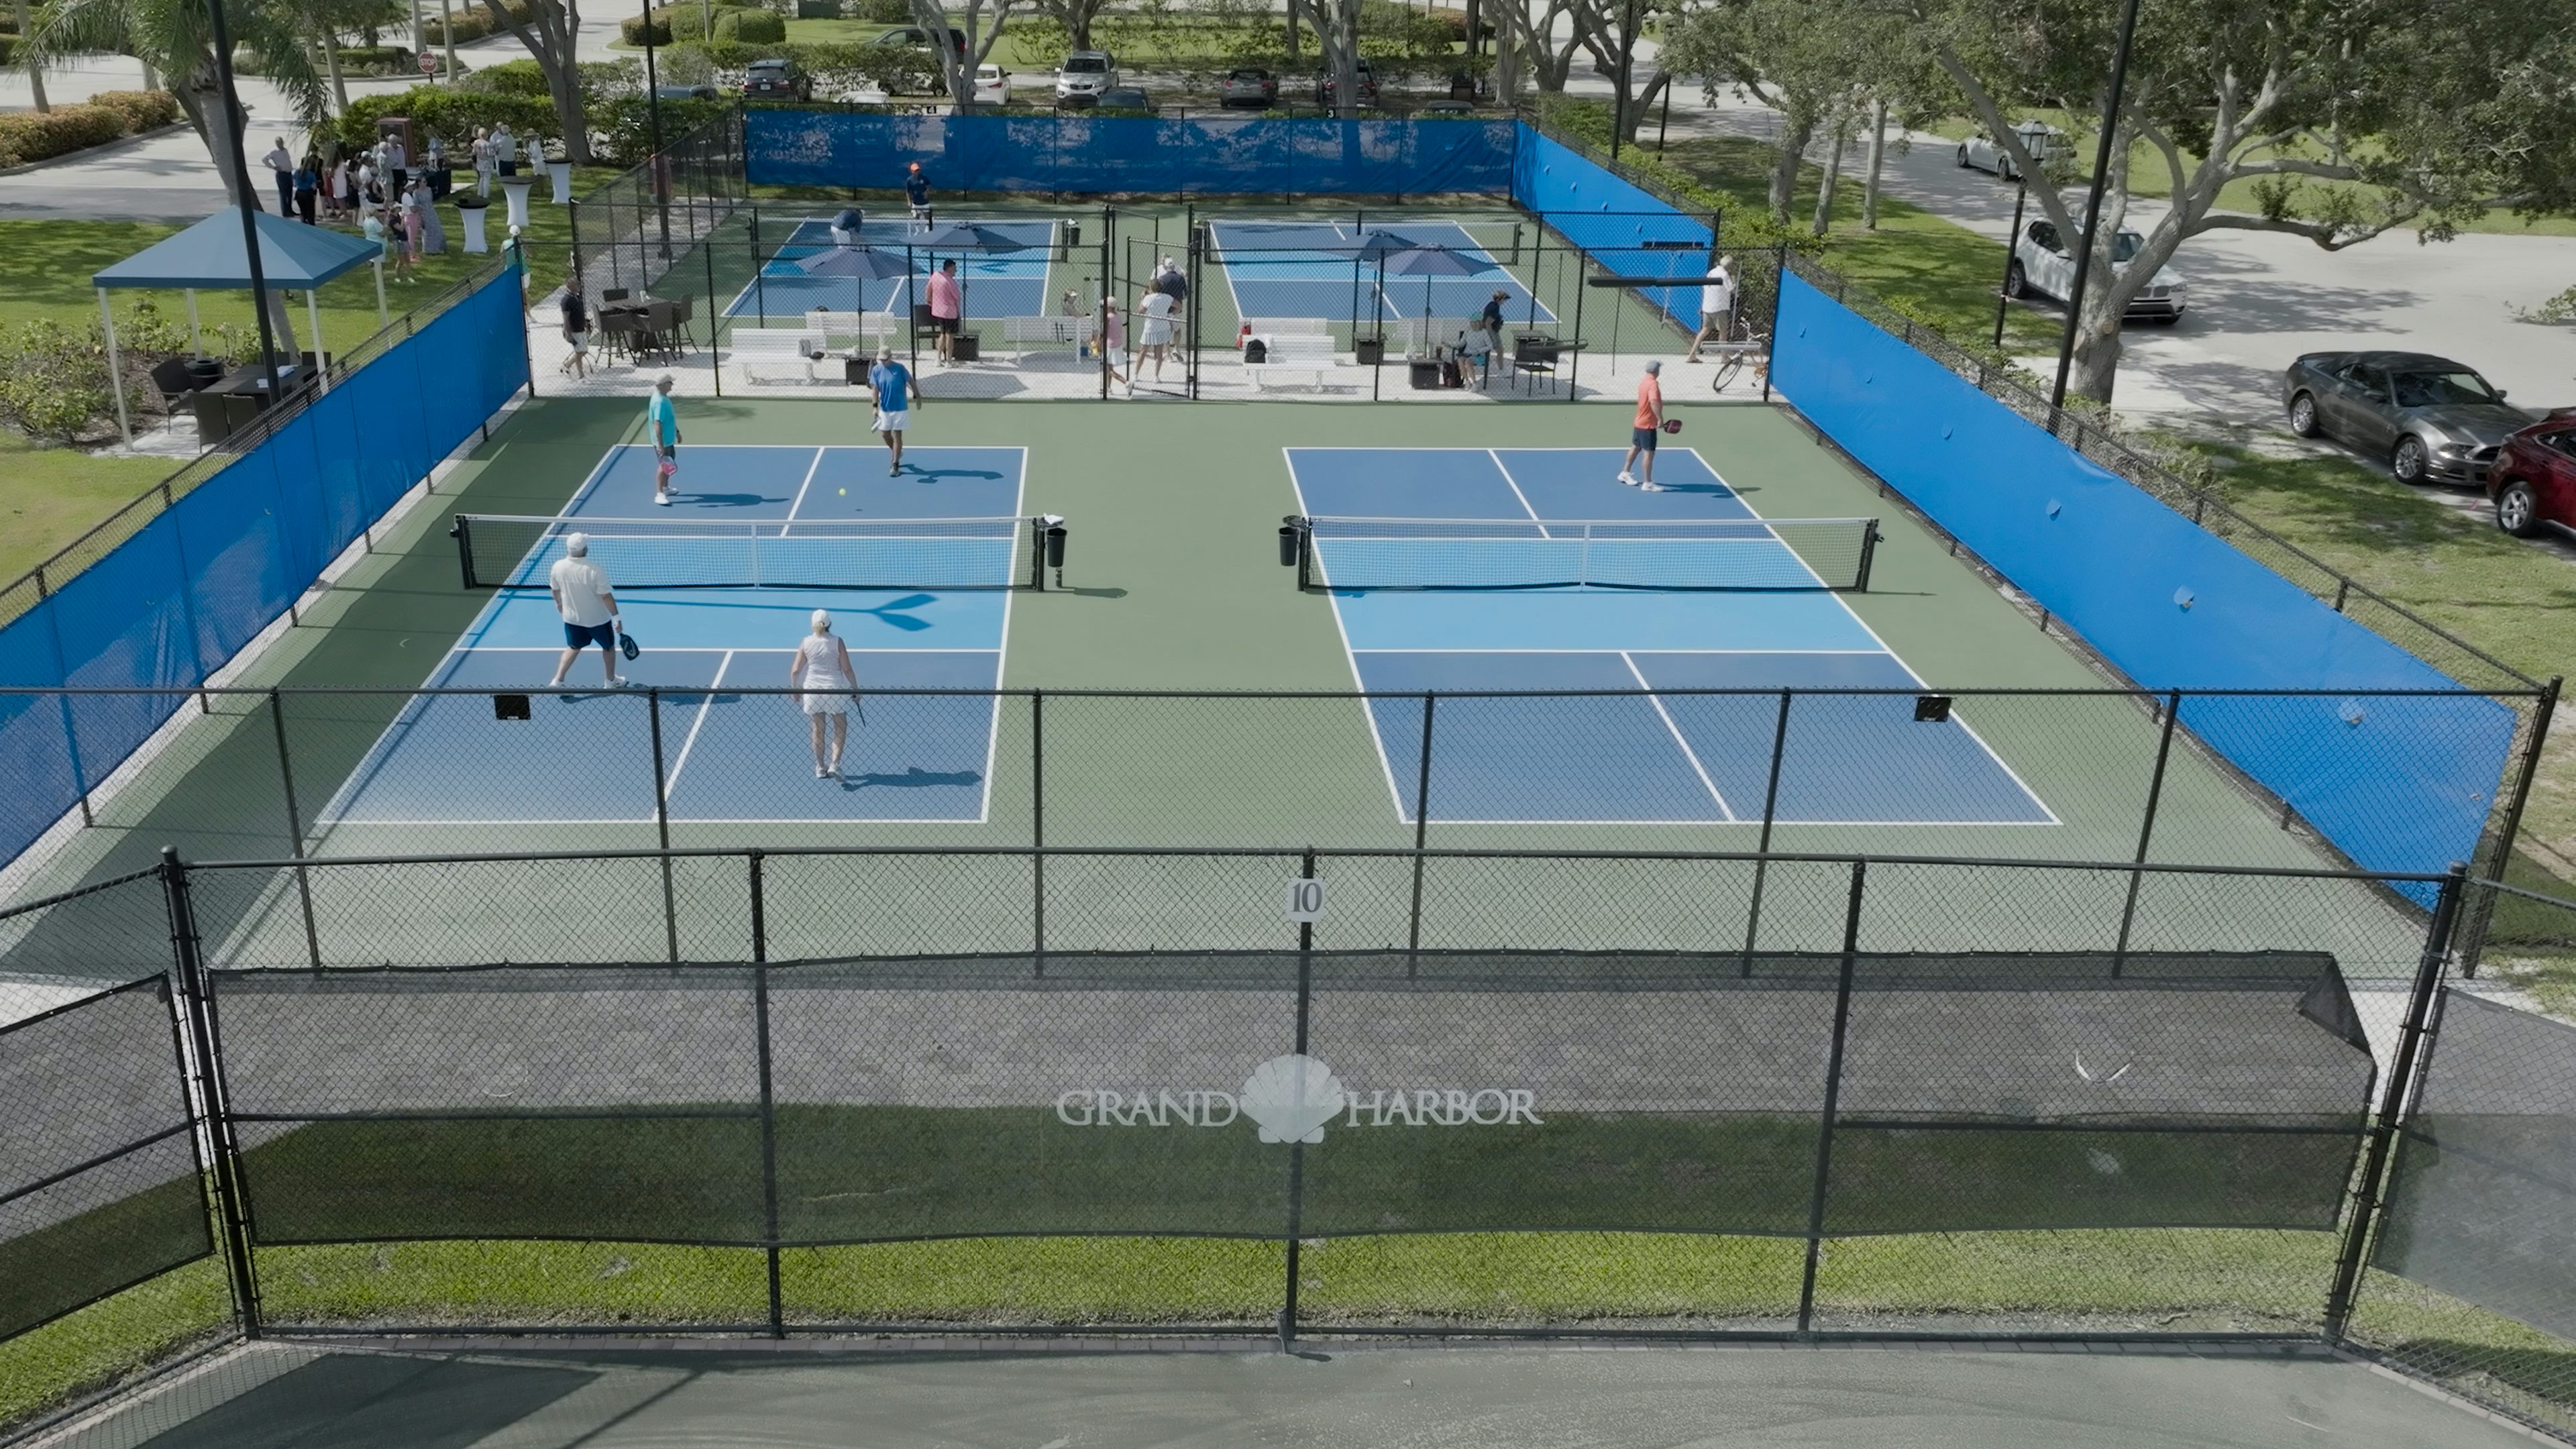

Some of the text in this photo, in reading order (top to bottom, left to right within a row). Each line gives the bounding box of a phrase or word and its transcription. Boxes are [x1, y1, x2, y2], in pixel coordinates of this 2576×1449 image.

[1328, 110, 1334, 118] 3
[1291, 882, 1322, 913] 10
[1056, 1088, 1545, 1127] GRAND HARBOR
